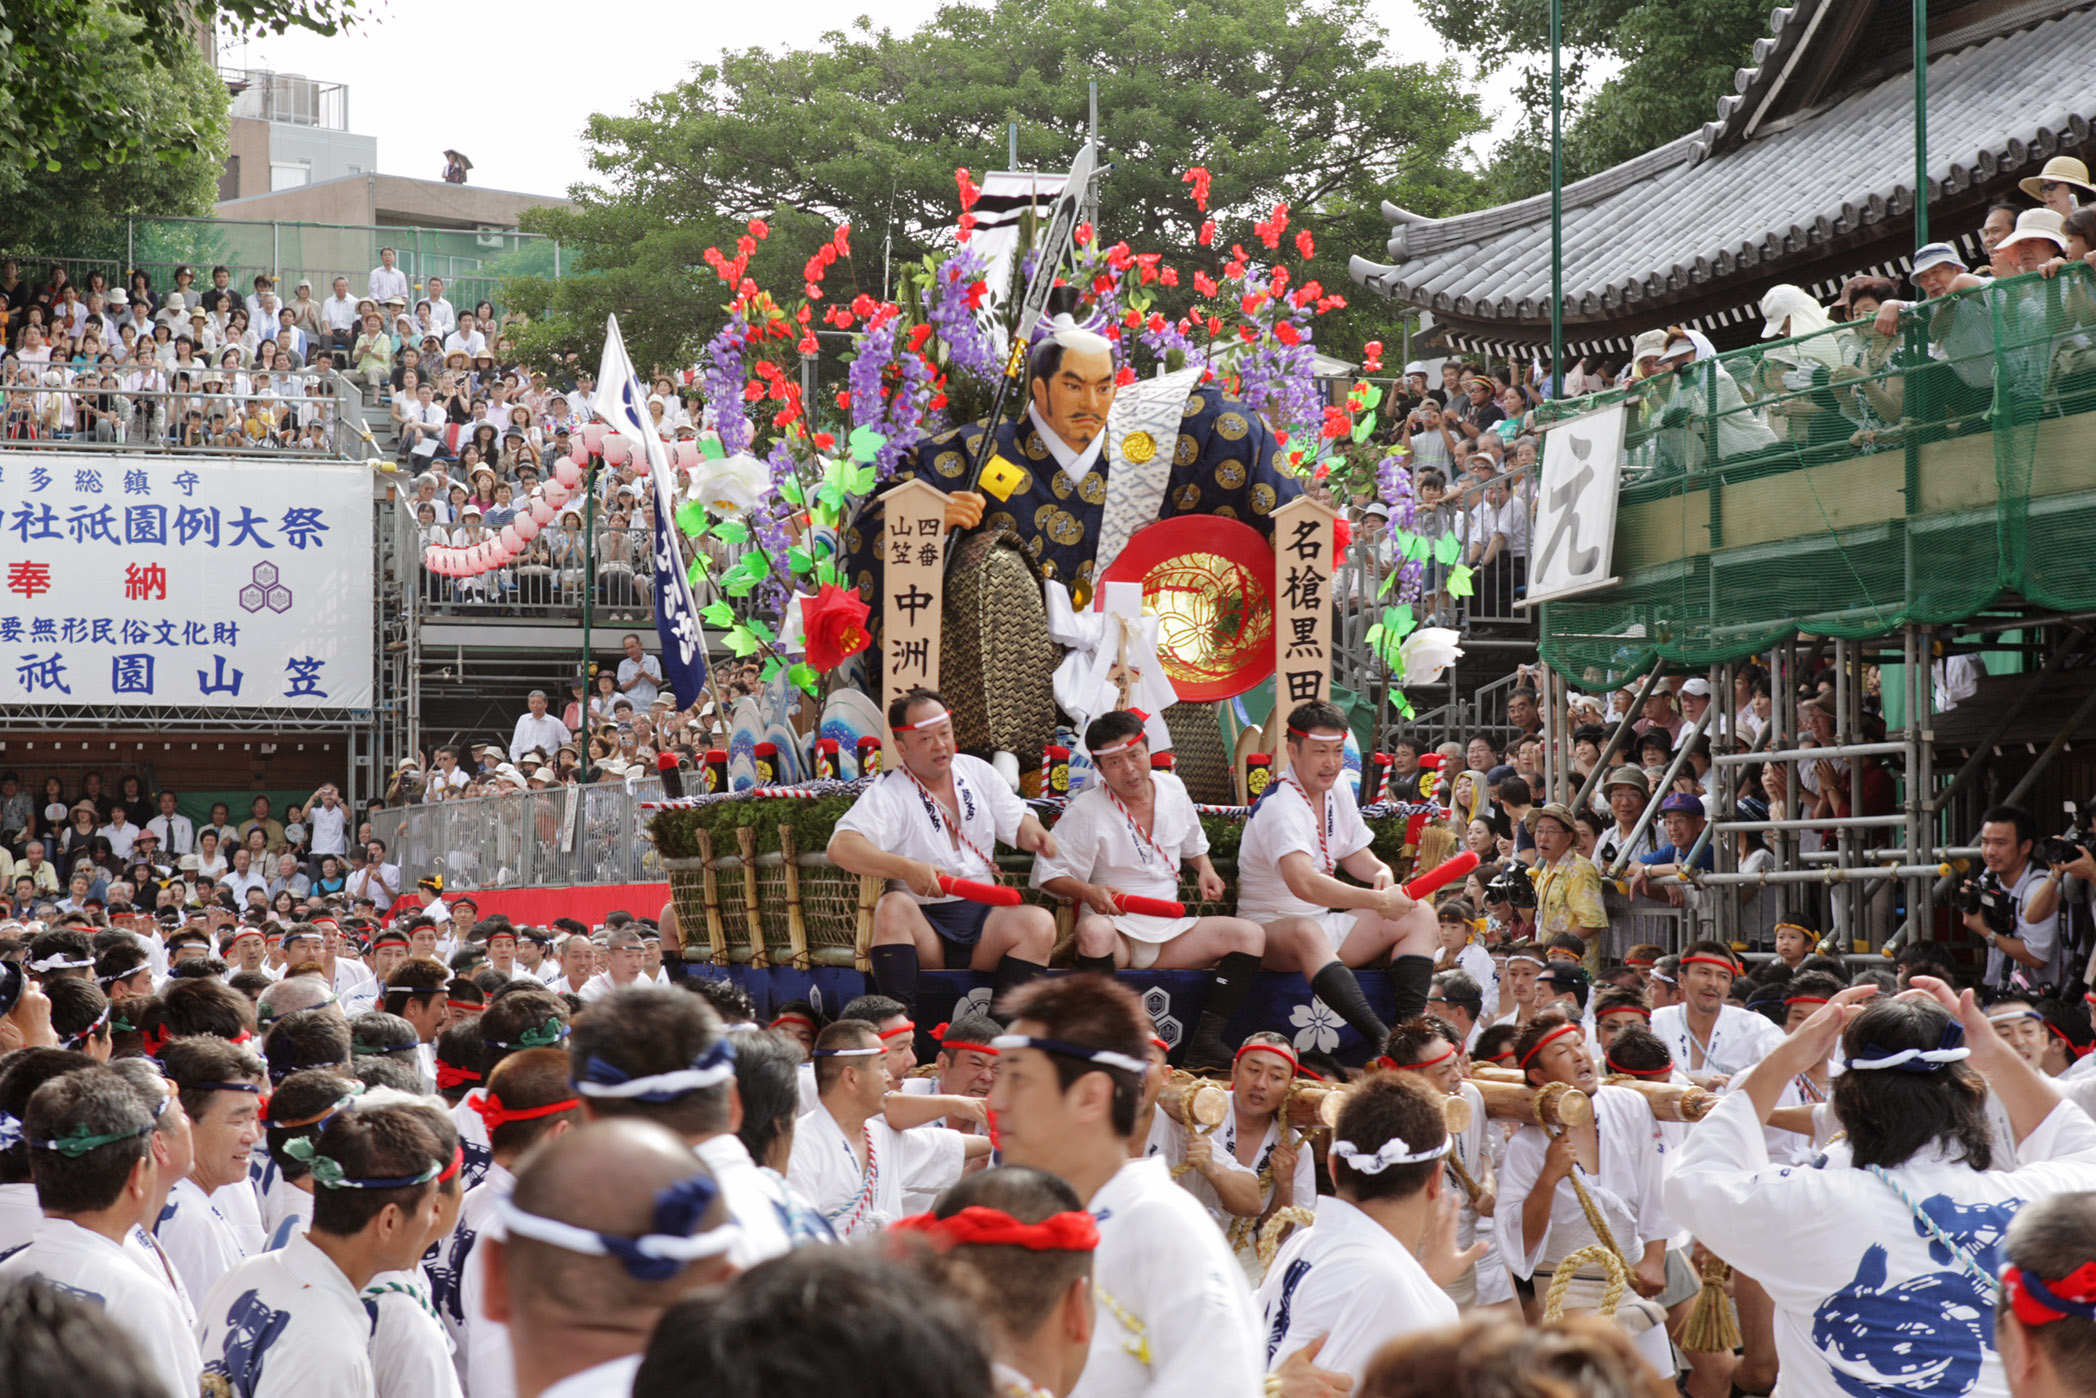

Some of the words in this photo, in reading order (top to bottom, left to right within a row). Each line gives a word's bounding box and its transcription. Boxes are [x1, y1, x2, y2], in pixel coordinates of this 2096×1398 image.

[0, 467, 200, 496] 多総鎮守
[0, 500, 330, 550] 社祇園例大祭
[1534, 432, 1600, 585] え
[890, 515, 913, 565] 山笠
[917, 518, 941, 567] 四番
[7, 560, 167, 601] 奉納
[1281, 520, 1327, 703] 名槍黒田
[15, 651, 329, 699] 祇園山笠
